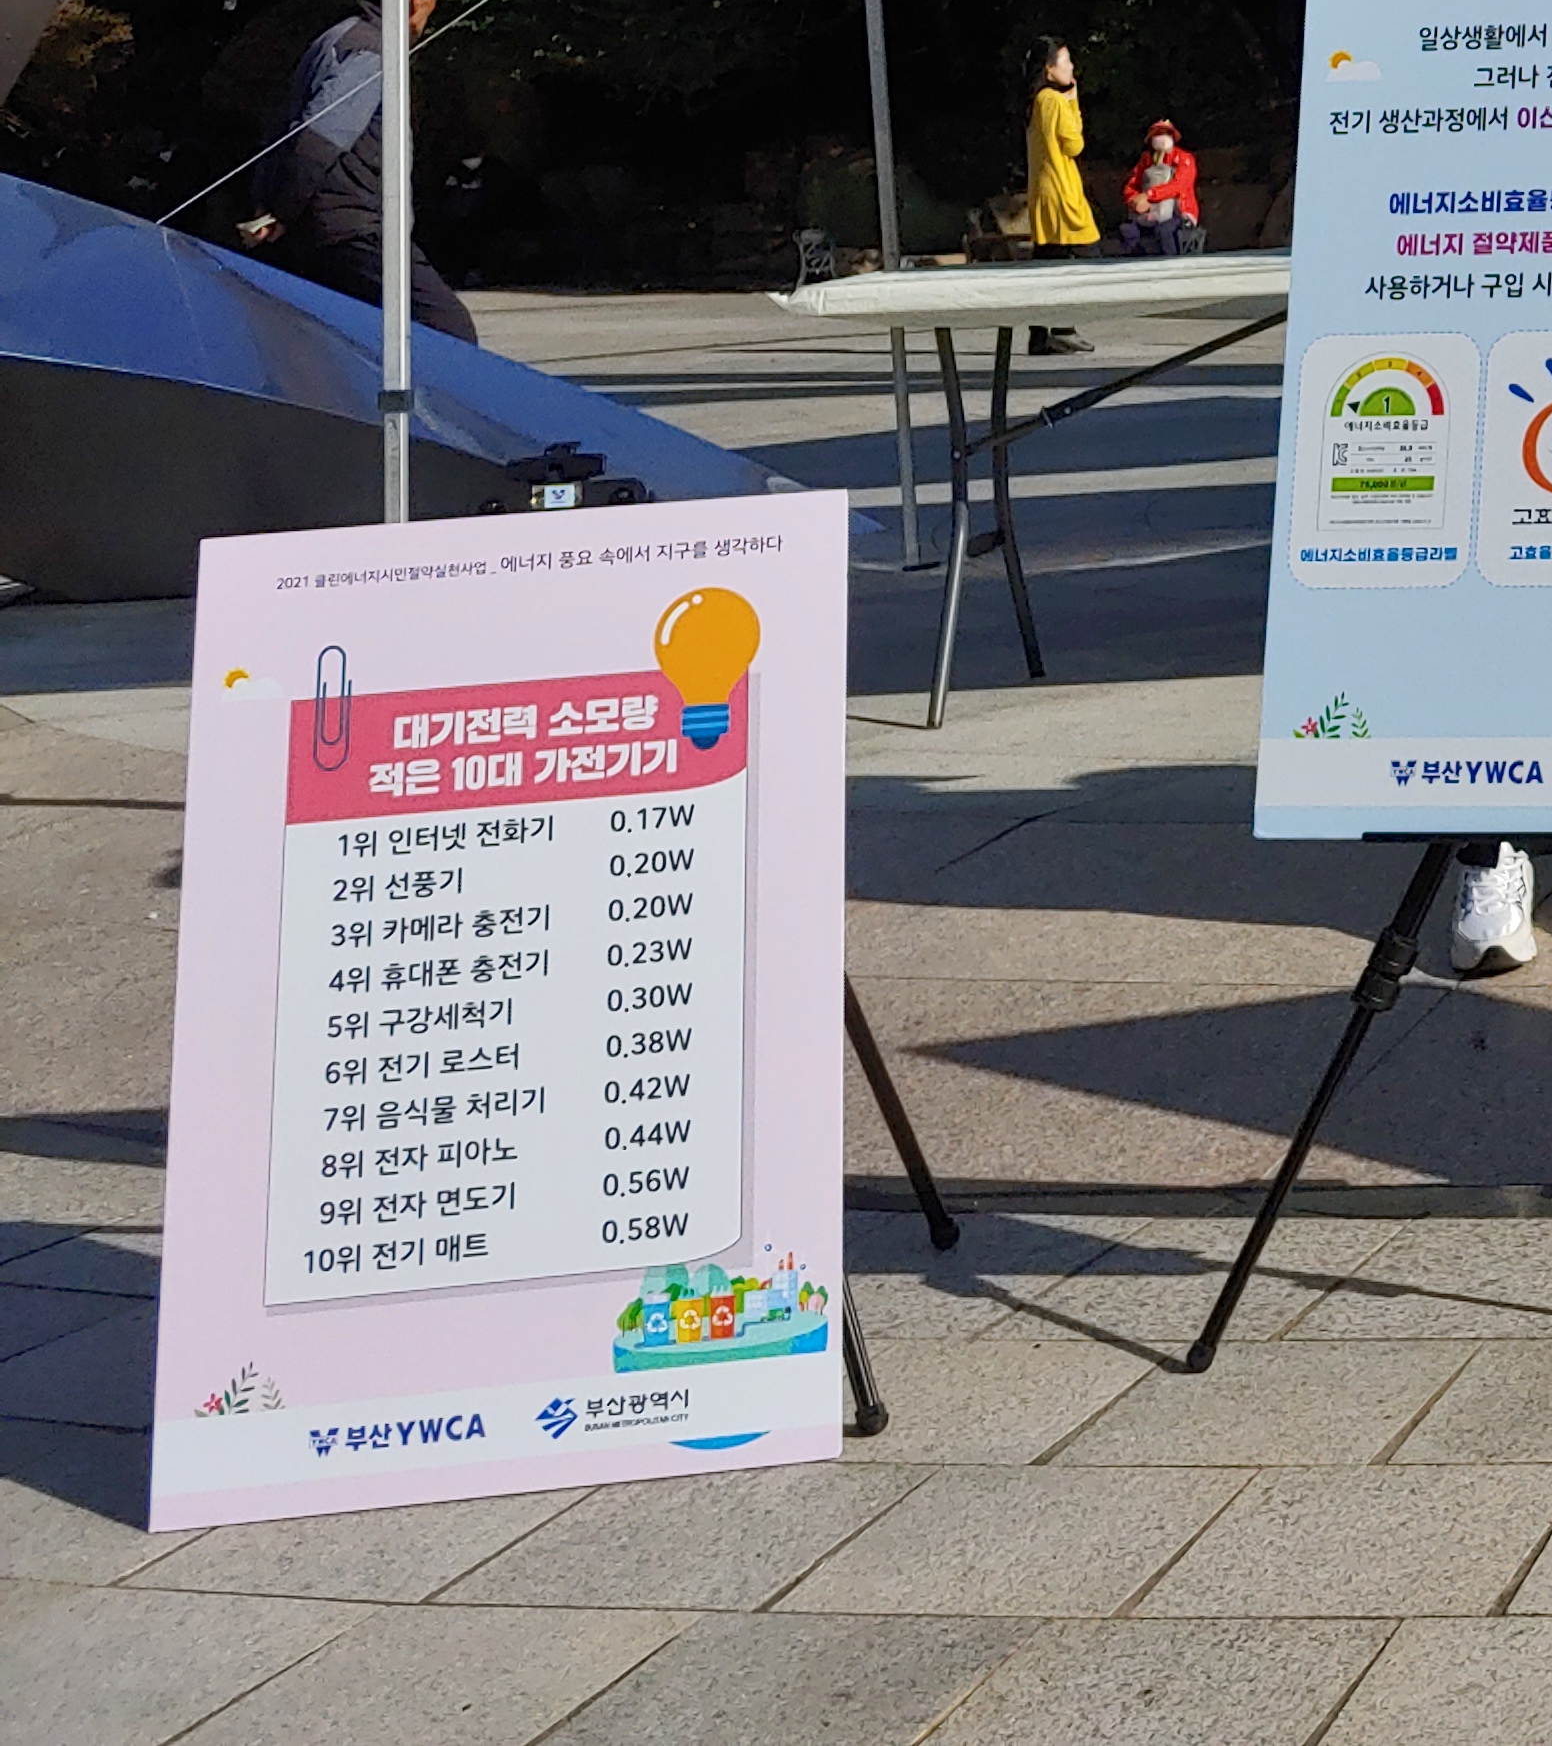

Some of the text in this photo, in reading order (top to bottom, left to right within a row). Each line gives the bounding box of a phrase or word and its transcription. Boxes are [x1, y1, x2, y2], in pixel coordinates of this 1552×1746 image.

[1420, 24, 1546, 51] 일상생활에서
[1474, 65, 1539, 89] 그러나
[1330, 110, 1370, 134] 전기
[1379, 107, 1507, 133] 생산과정에서
[1397, 233, 1463, 256] 에너지
[1365, 274, 1474, 300] 사용하거나
[1481, 273, 1523, 298] 구입
[1532, 272, 1551, 296] 시
[277, 535, 782, 589] 2021 클린에너지시민절약실천사업 에너지 풍요 속에서 지구를 생각하다
[394, 695, 658, 748] 대기전력 소모량
[369, 739, 677, 796] 적은 10대 가전기기
[339, 804, 694, 857] 1위 인터넷 전화기 0.17W
[333, 849, 694, 902] 2위 선풍기 0.20W
[332, 893, 693, 947] 3위 카메라 충전기 0.20W
[586, 1388, 690, 1418] 부산광역시
